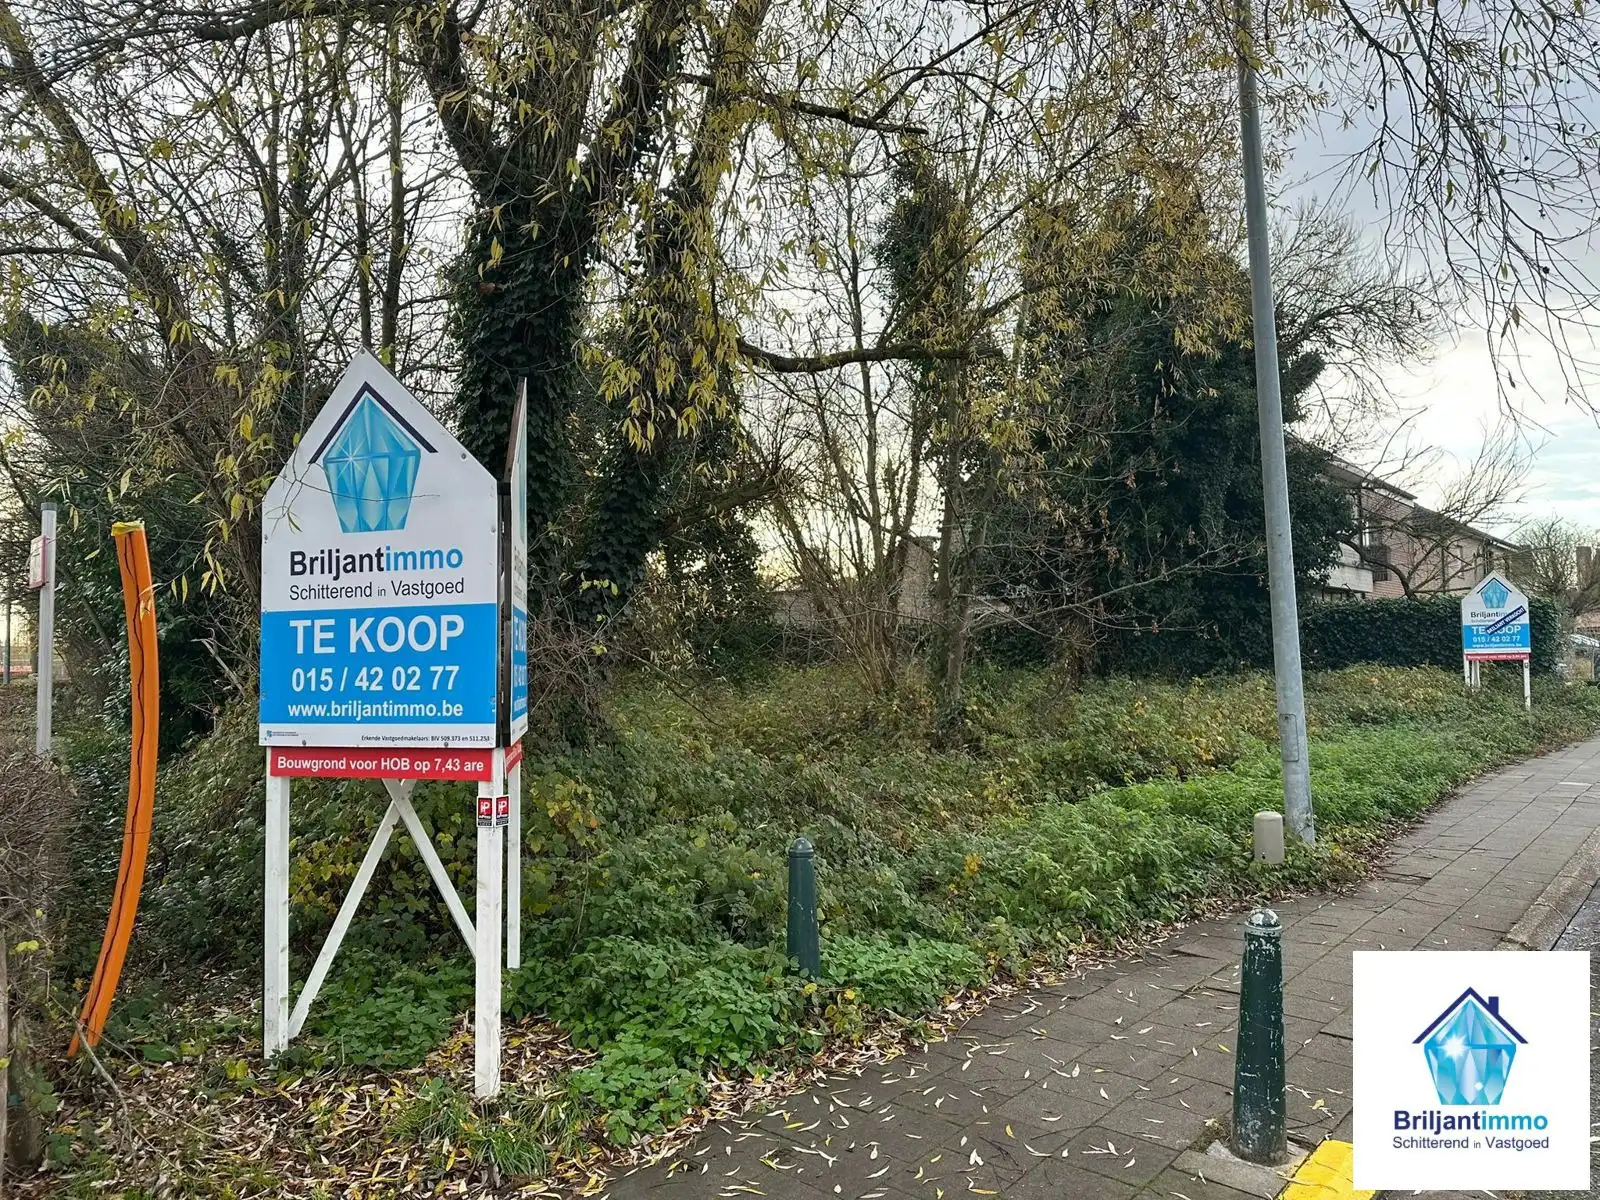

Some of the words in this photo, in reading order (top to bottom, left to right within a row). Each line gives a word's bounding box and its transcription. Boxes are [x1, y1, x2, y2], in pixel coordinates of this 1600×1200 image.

[290, 545, 464, 581] Briljantimmo
[289, 581, 373, 601] Schitterend
[377, 586, 387, 597] in
[391, 577, 465, 599] Vastgoed
[289, 618, 336, 654] TE
[350, 614, 465, 653] KOOP
[1471, 626, 1486, 635] TE
[291, 668, 334, 692] 015
[340, 667, 348, 692] /
[354, 666, 384, 691] 42
[391, 666, 421, 691] 02
[430, 665, 460, 691] 77
[288, 700, 464, 722] www.briljantimmo.be
[277, 756, 346, 772] Bouwgrond
[350, 759, 377, 771] voor
[381, 758, 410, 771] HOB
[416, 761, 431, 774] op
[434, 758, 461, 773] 7,43
[464, 761, 484, 772] are
